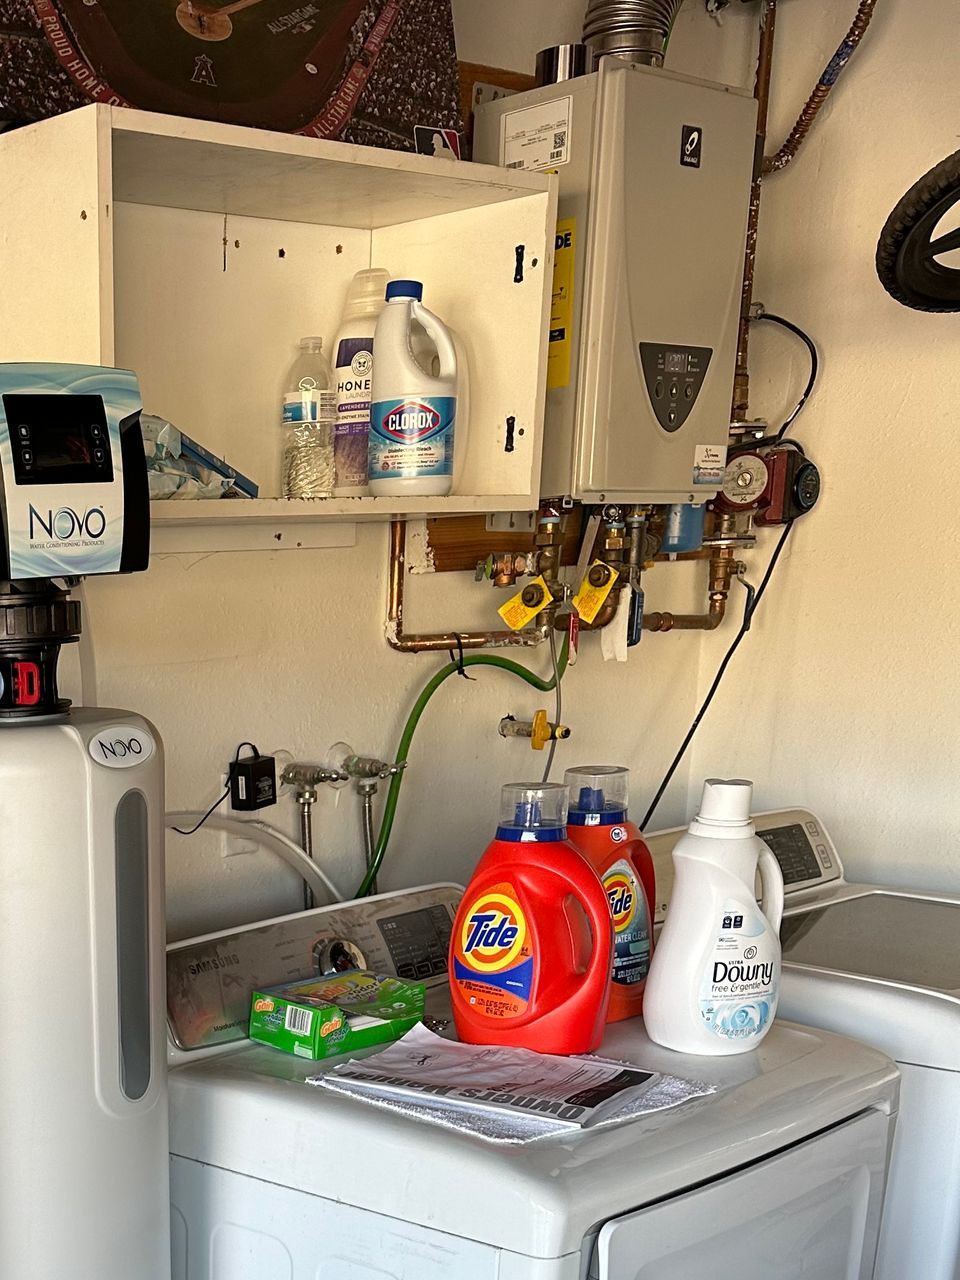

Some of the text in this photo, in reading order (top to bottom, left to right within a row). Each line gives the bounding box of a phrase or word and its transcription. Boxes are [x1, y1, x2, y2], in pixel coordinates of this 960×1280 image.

[43, 15, 73, 57] PROUD
[67, 59, 106, 98] HOME
[343, 78, 360, 103] GAME
[388, 411, 434, 431] CLOROX
[97, 737, 142, 759] NOVO
[463, 912, 519, 953] Tide
[188, 953, 241, 976] SAMSUNG
[712, 960, 774, 986] Downy
[711, 984, 729, 993] free
[739, 980, 761, 993] gentle
[254, 998, 275, 1012] Gain
[320, 1017, 342, 1038] Gain
[458, 1087, 586, 1120] Owners
